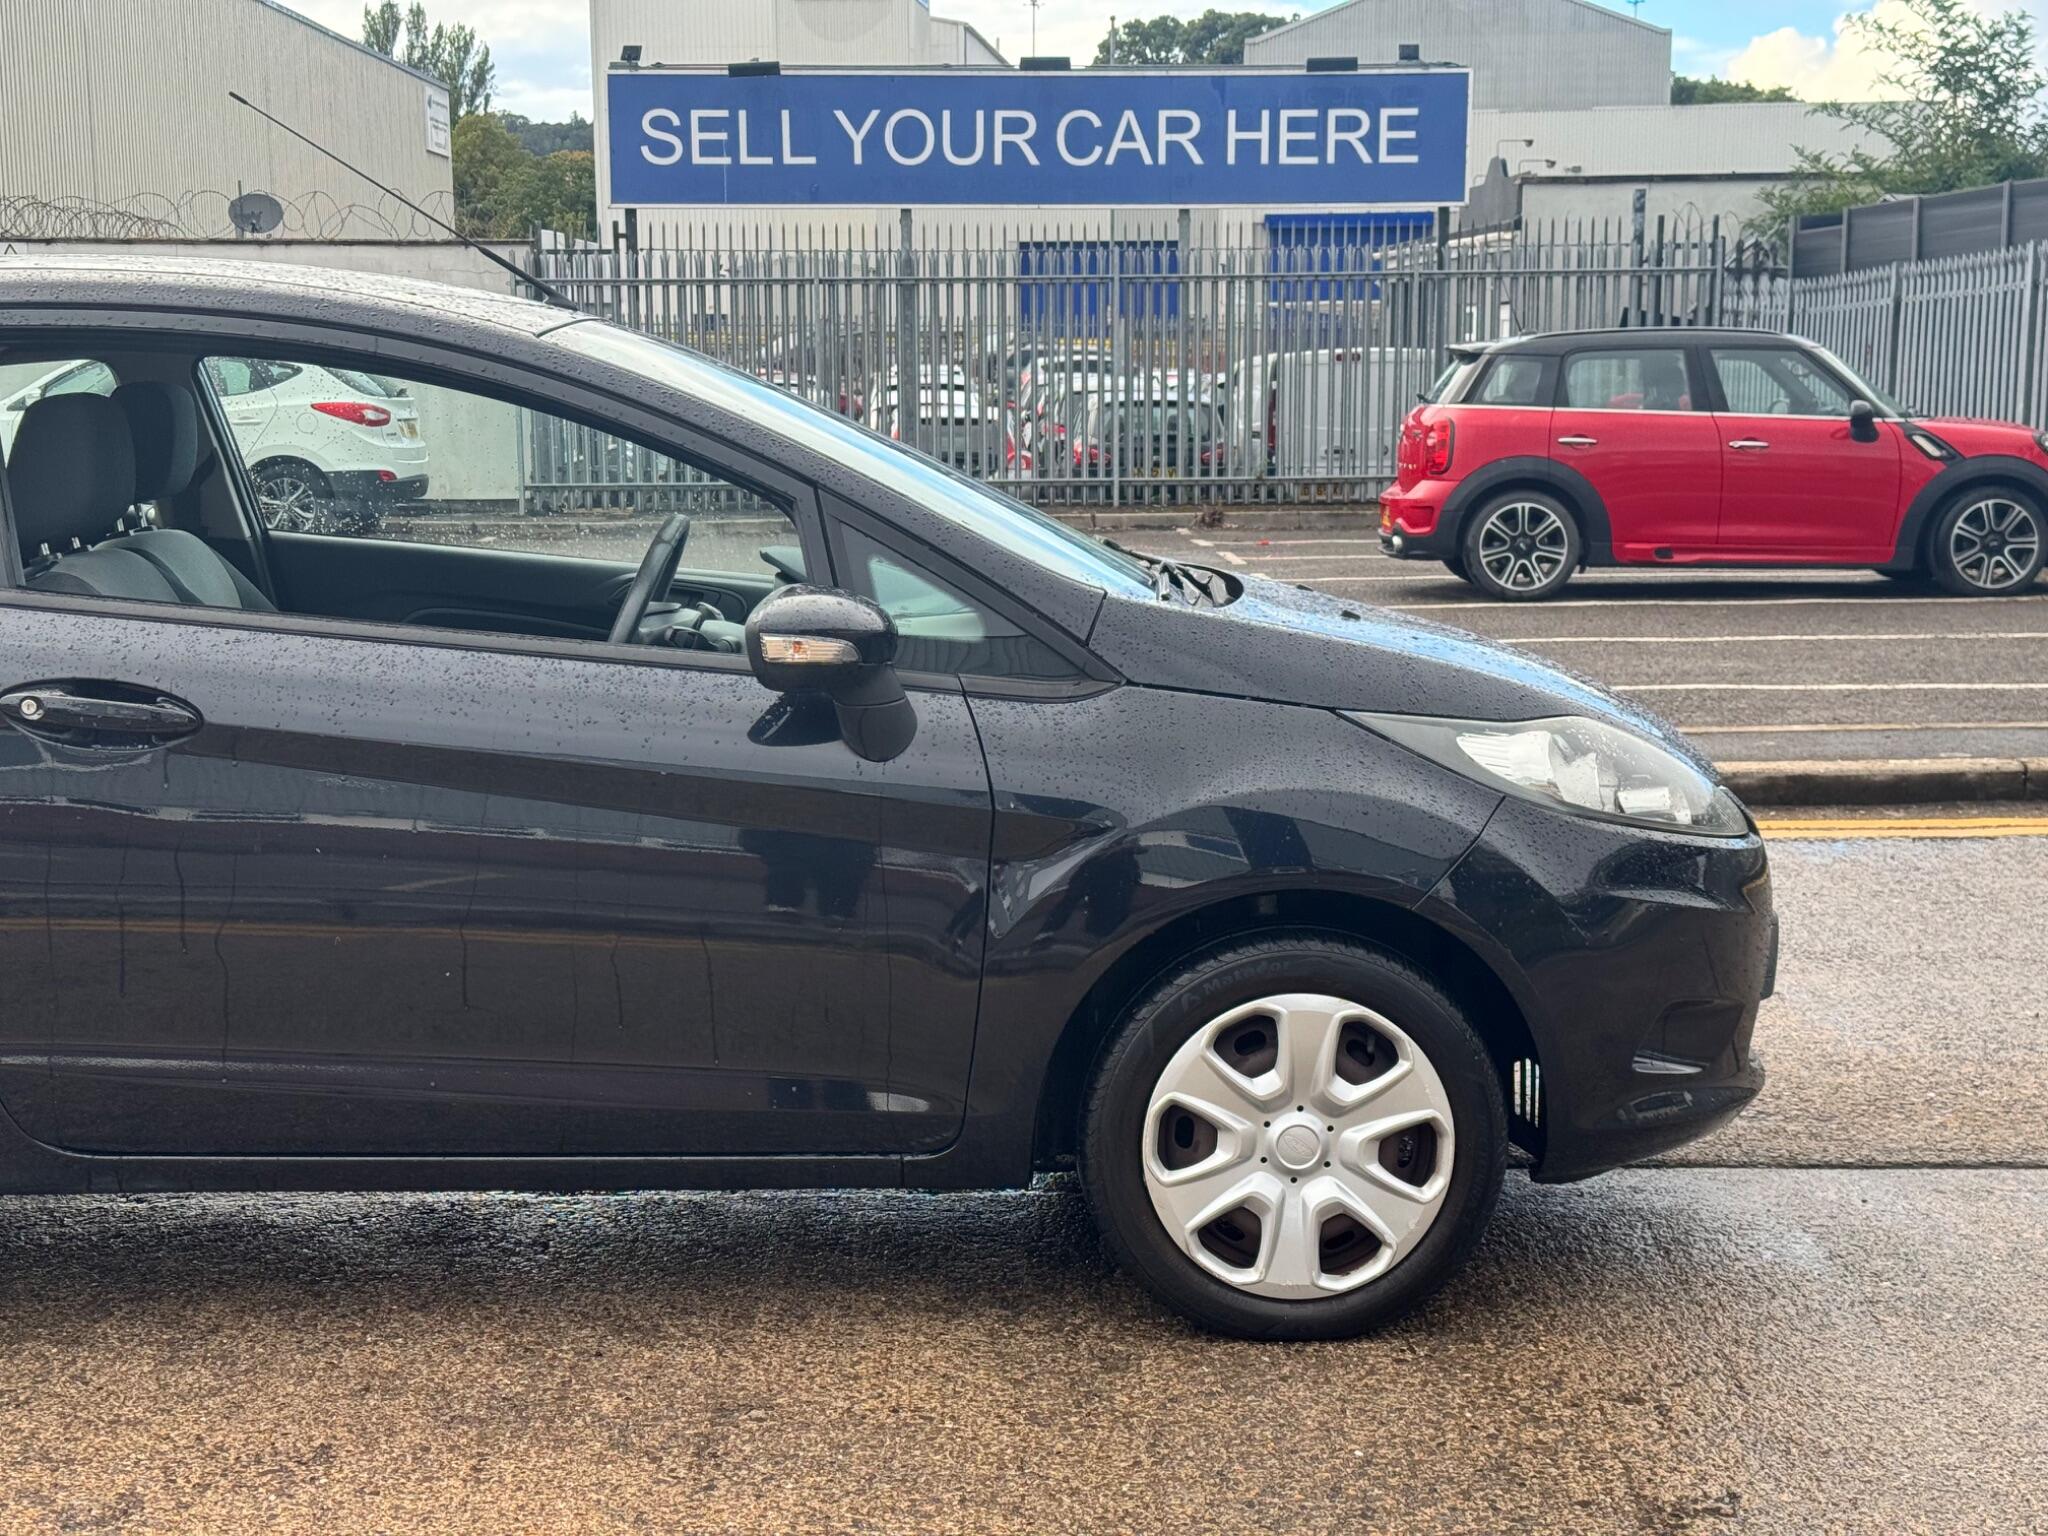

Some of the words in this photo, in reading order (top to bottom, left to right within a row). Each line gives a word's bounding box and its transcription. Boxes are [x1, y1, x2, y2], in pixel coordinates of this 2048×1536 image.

[640, 108, 817, 166] SELL
[833, 108, 1040, 166] YOUR
[1056, 109, 1204, 166] CAR
[1226, 107, 1419, 165] HERE
